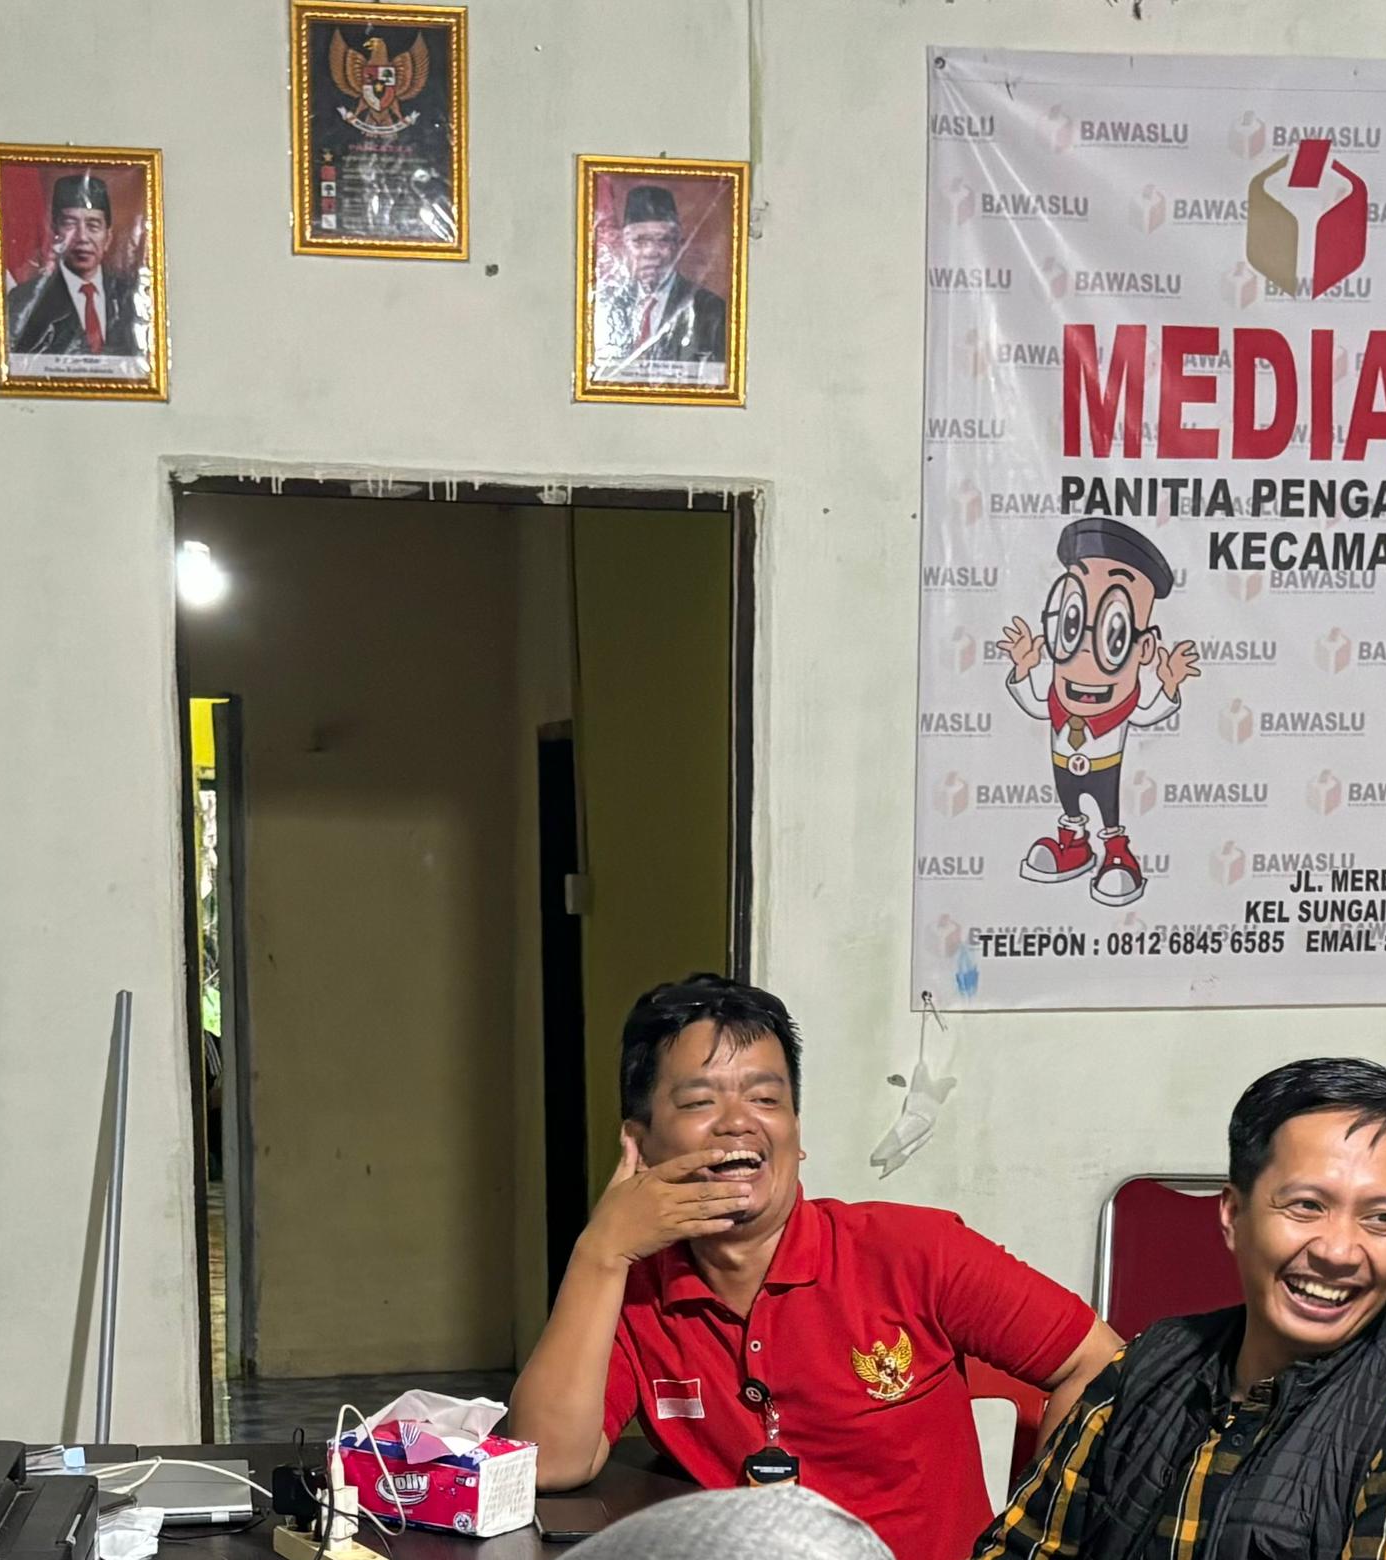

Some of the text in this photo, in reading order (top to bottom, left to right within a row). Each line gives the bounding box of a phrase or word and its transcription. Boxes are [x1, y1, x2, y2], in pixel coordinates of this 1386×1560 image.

[1080, 120, 1189, 144] BAWASLU
[929, 267, 1011, 289] WASLU
[1074, 270, 1182, 294] BAWASLU
[1061, 475, 1235, 518] PANITIA
[1270, 569, 1376, 589] BAWASLU
[1260, 712, 1366, 732] BAWASLU
[1163, 783, 1268, 803] BAWASLU
[1252, 853, 1355, 872] BAWASLU
[1289, 869, 1323, 893] JL.
[1245, 900, 1290, 924] KEL
[1297, 899, 1386, 924] SUNGAI
[978, 933, 1086, 958] TELEPON
[1107, 932, 1161, 956] 0812
[1168, 931, 1223, 955] 6845
[1230, 930, 1285, 954] 6585
[1306, 929, 1377, 953] EMAIL
